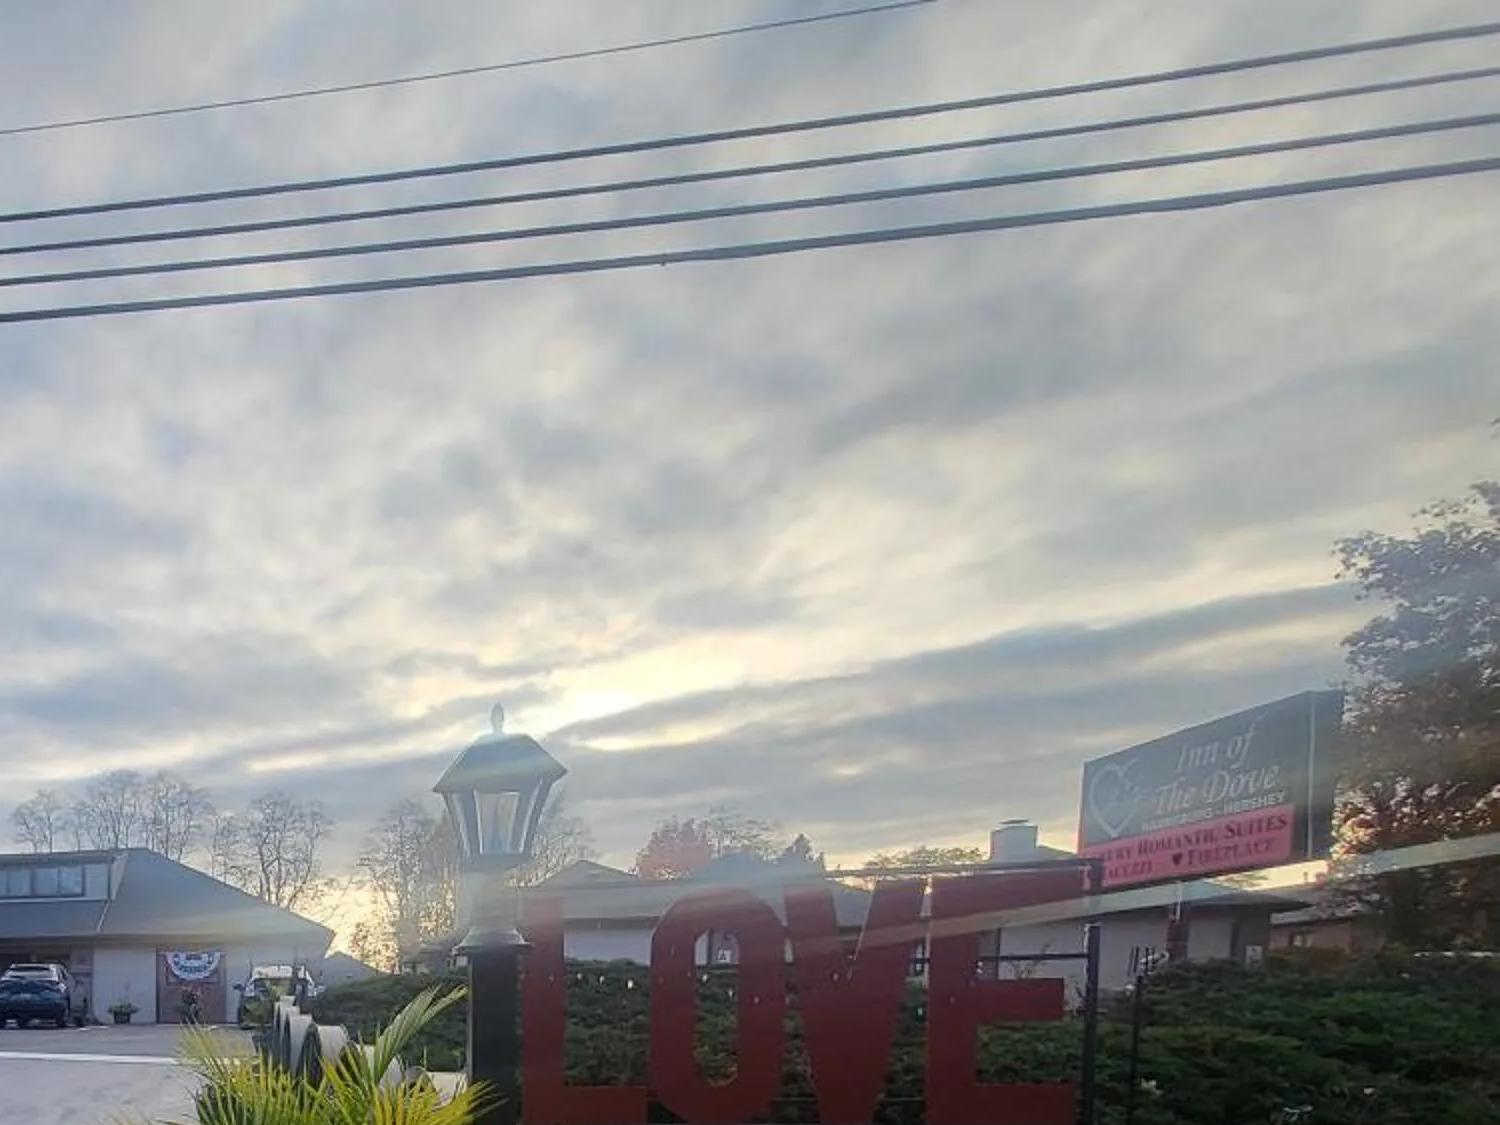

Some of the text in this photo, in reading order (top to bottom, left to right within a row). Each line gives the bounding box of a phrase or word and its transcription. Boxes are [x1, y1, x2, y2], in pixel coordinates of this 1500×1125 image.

[1178, 716, 1265, 774] Inn of
[1154, 765, 1280, 815] The Dove
[1223, 814, 1288, 840] SUITES
